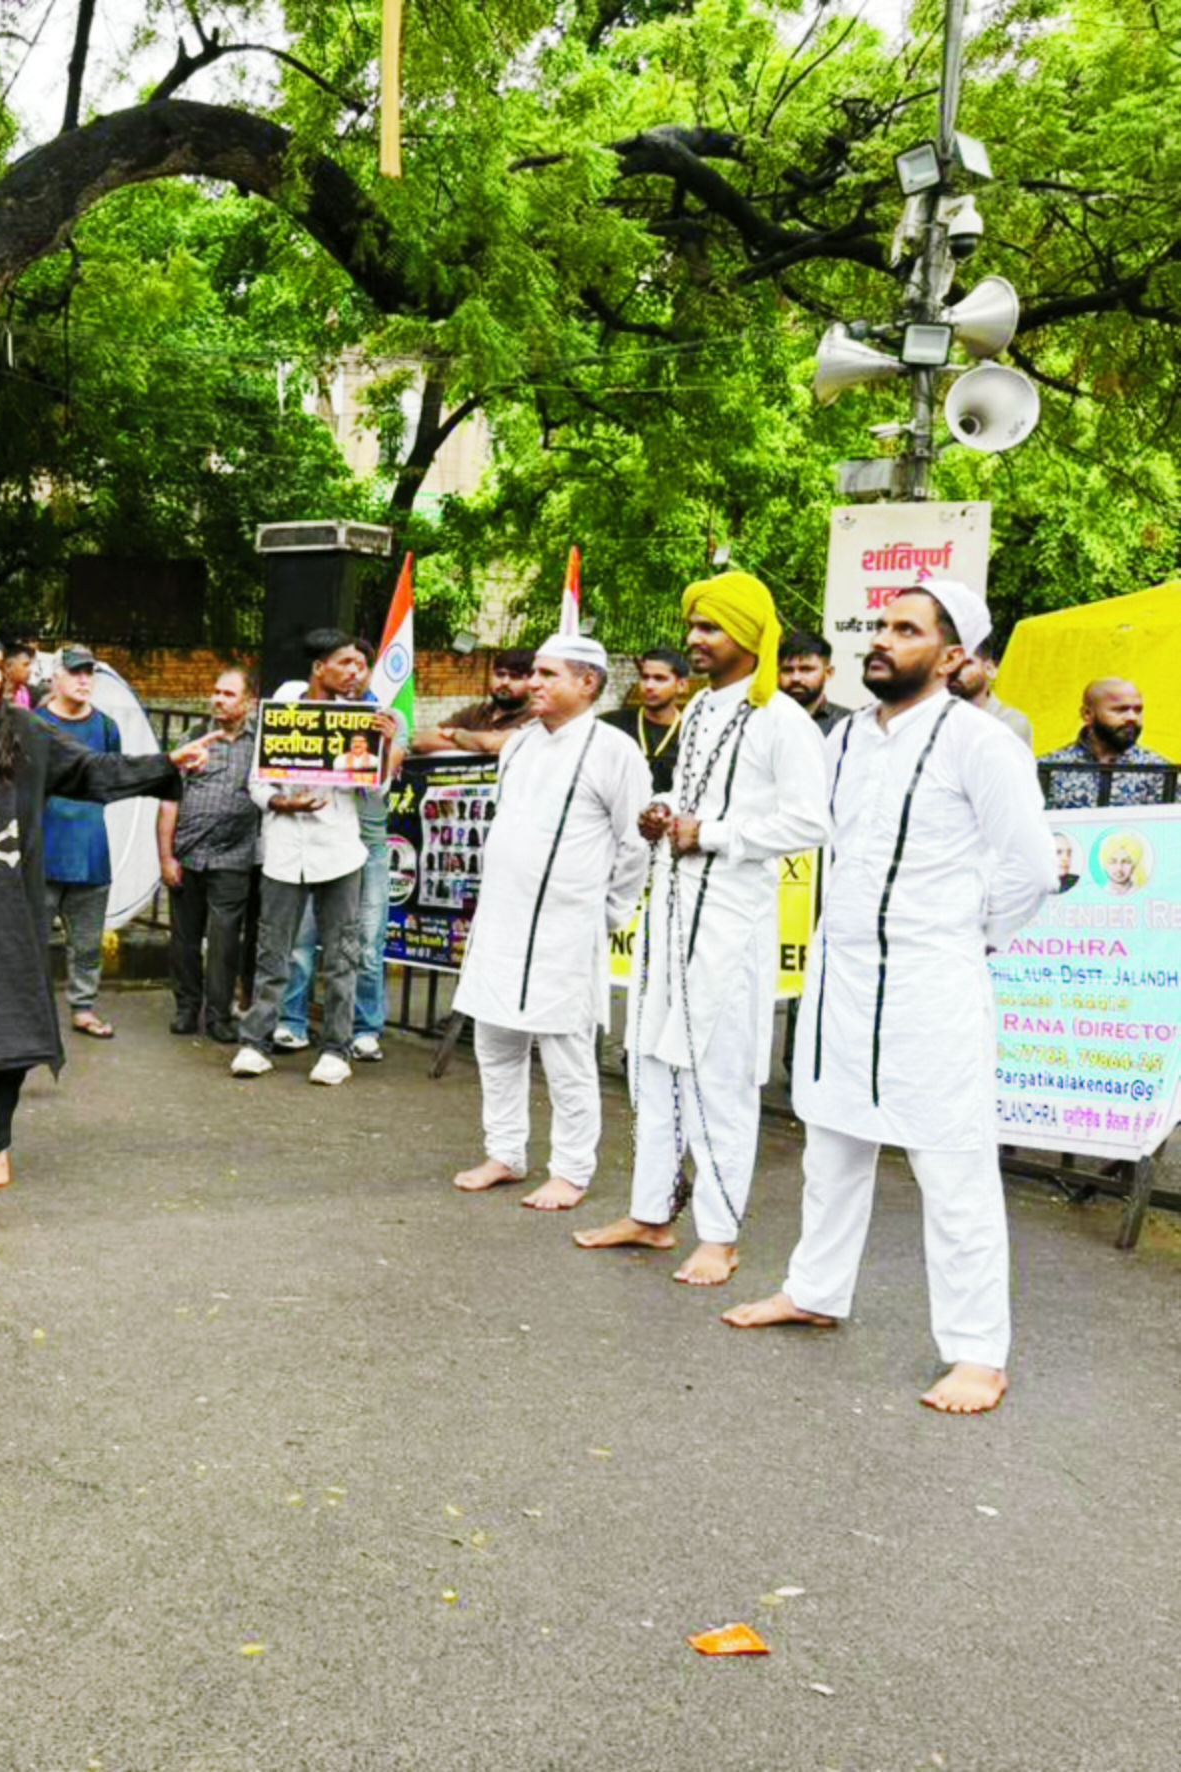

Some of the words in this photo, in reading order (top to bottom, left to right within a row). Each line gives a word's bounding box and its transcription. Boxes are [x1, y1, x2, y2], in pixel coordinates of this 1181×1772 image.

[861, 541, 954, 582] शांतिपूर्ण
[1048, 903, 1138, 929] KENDER
[1002, 938, 1128, 957] ANDHRA
[1003, 1013, 1065, 1035] RANA
[1073, 1016, 1177, 1043] (DIRECTO
